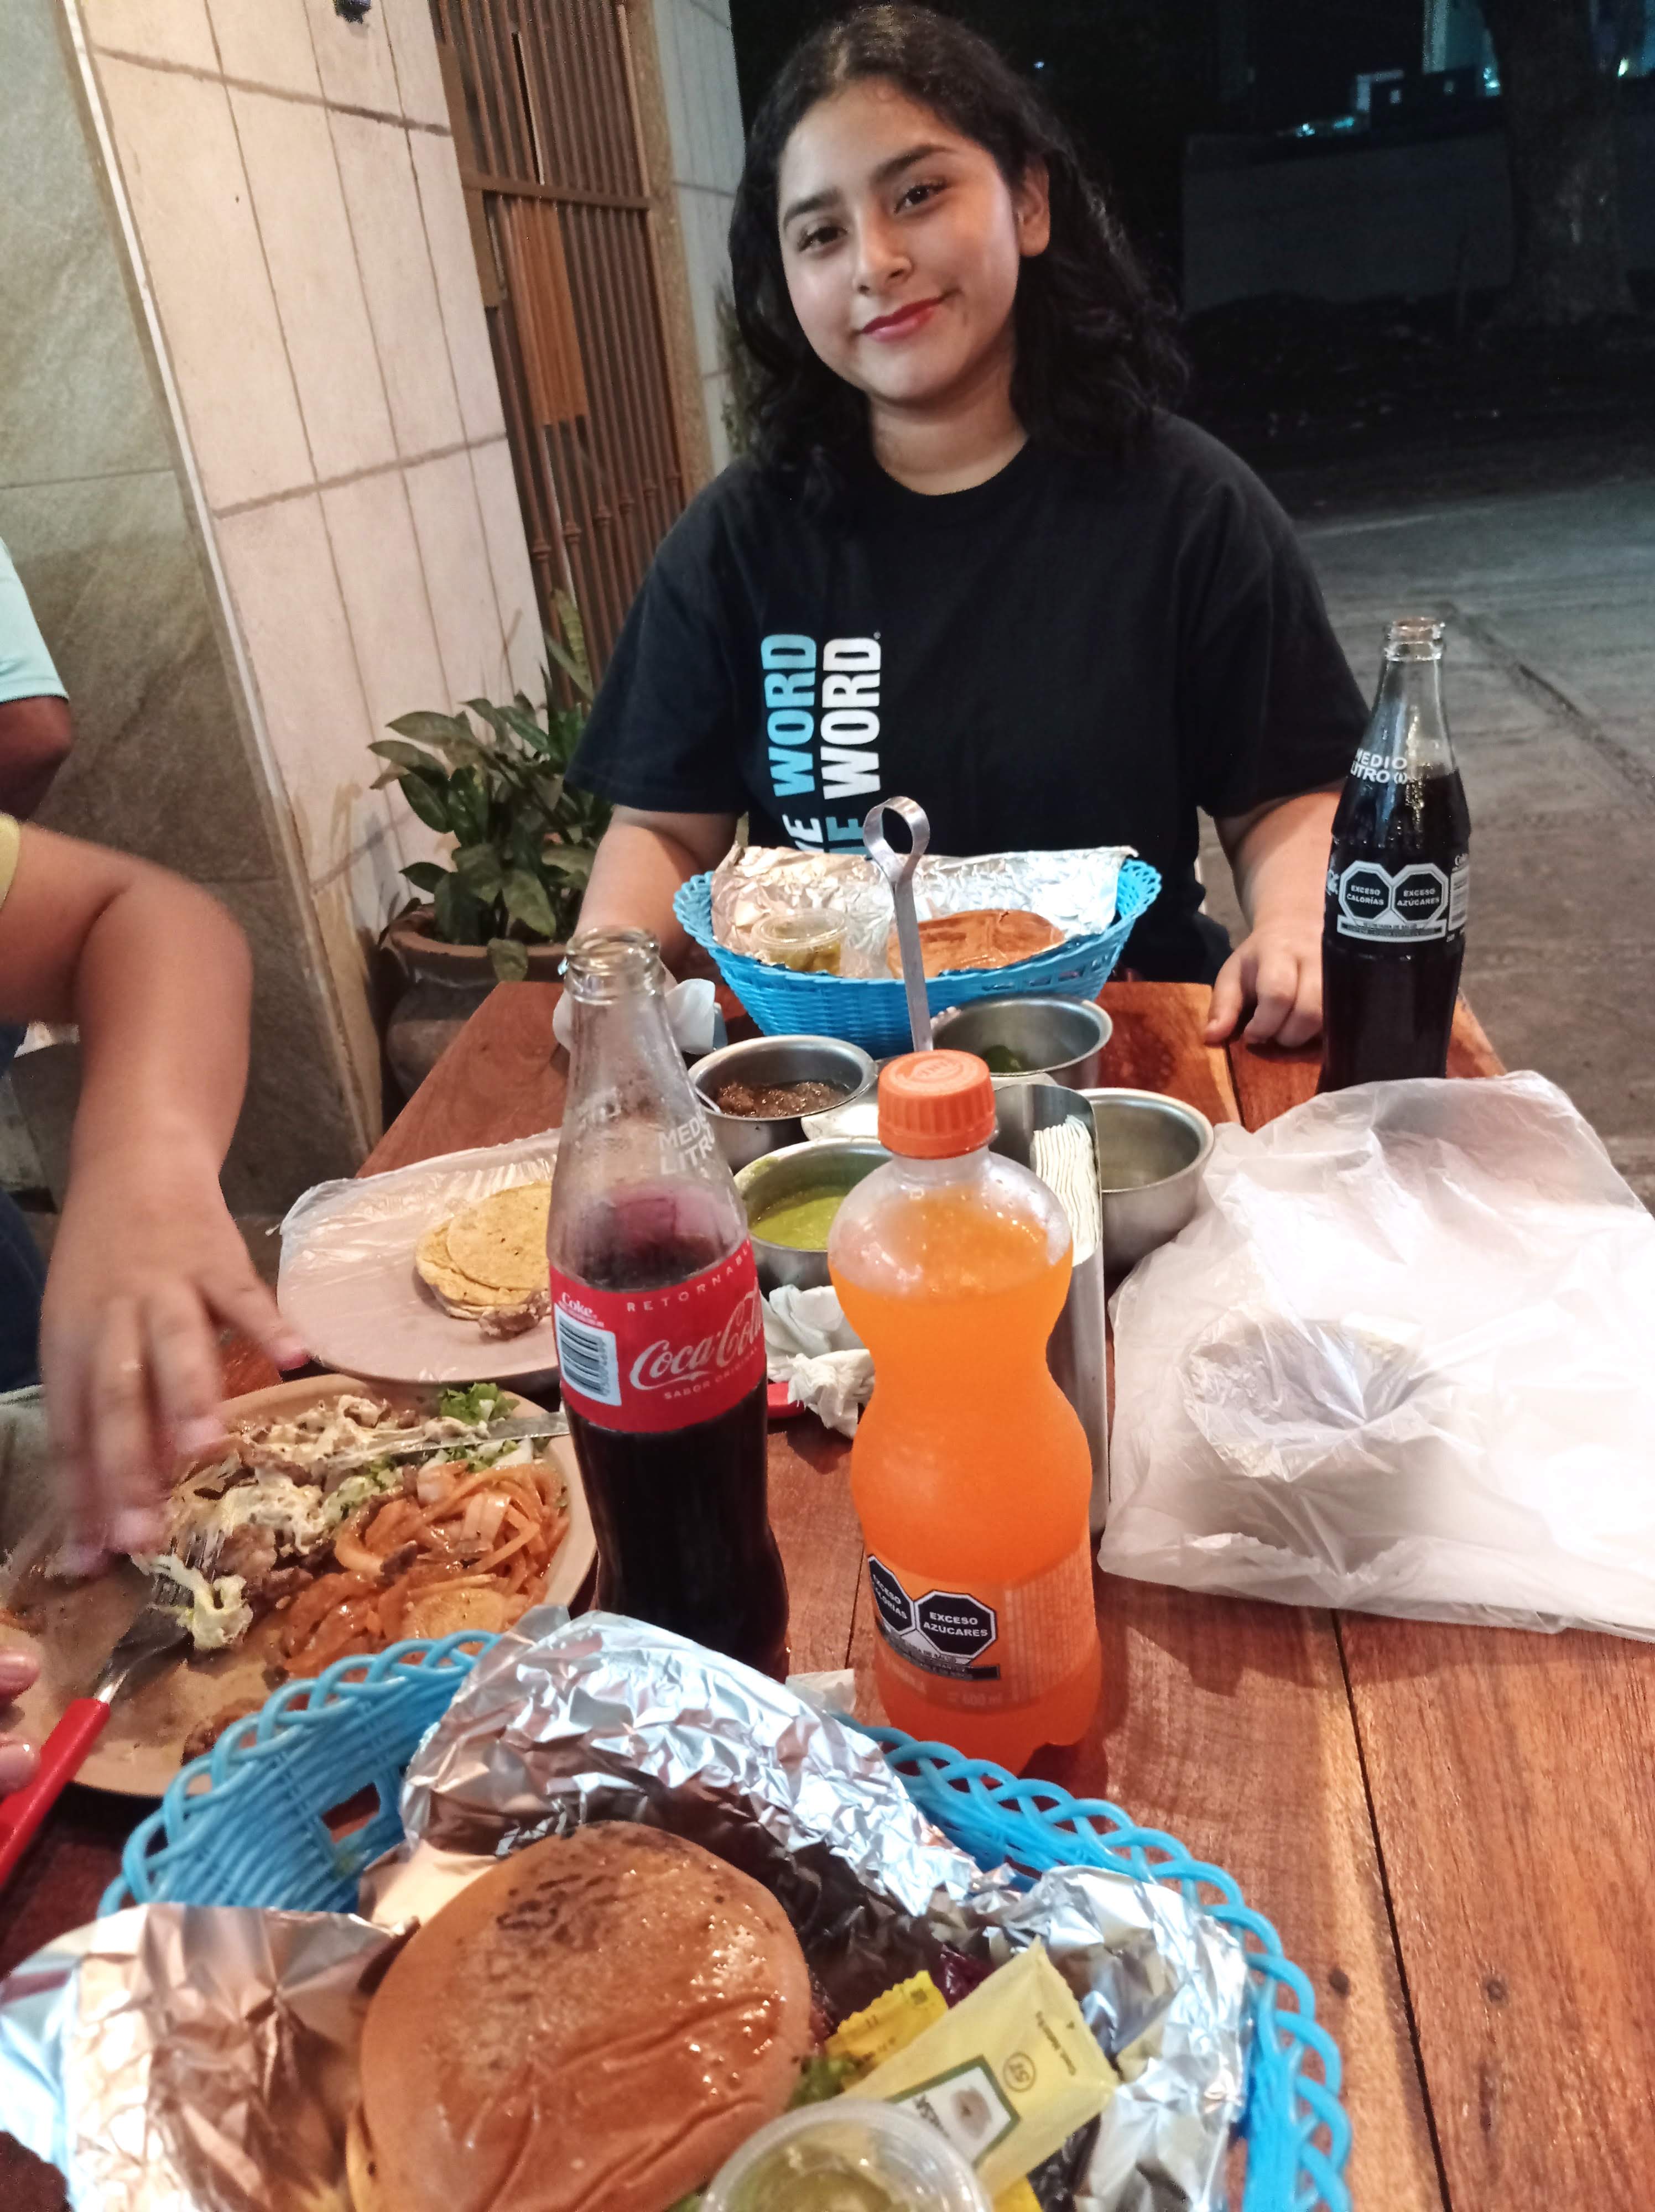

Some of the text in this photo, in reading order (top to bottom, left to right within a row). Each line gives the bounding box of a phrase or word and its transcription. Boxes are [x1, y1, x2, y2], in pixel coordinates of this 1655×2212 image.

[761, 634, 817, 797] WORD
[820, 637, 882, 800] WORD
[1351, 885, 1381, 896] EXCESO
[1403, 888, 1437, 898] EXCESO
[664, 1380, 710, 1400] SABOR
[929, 1611, 979, 1625] EXCESO
